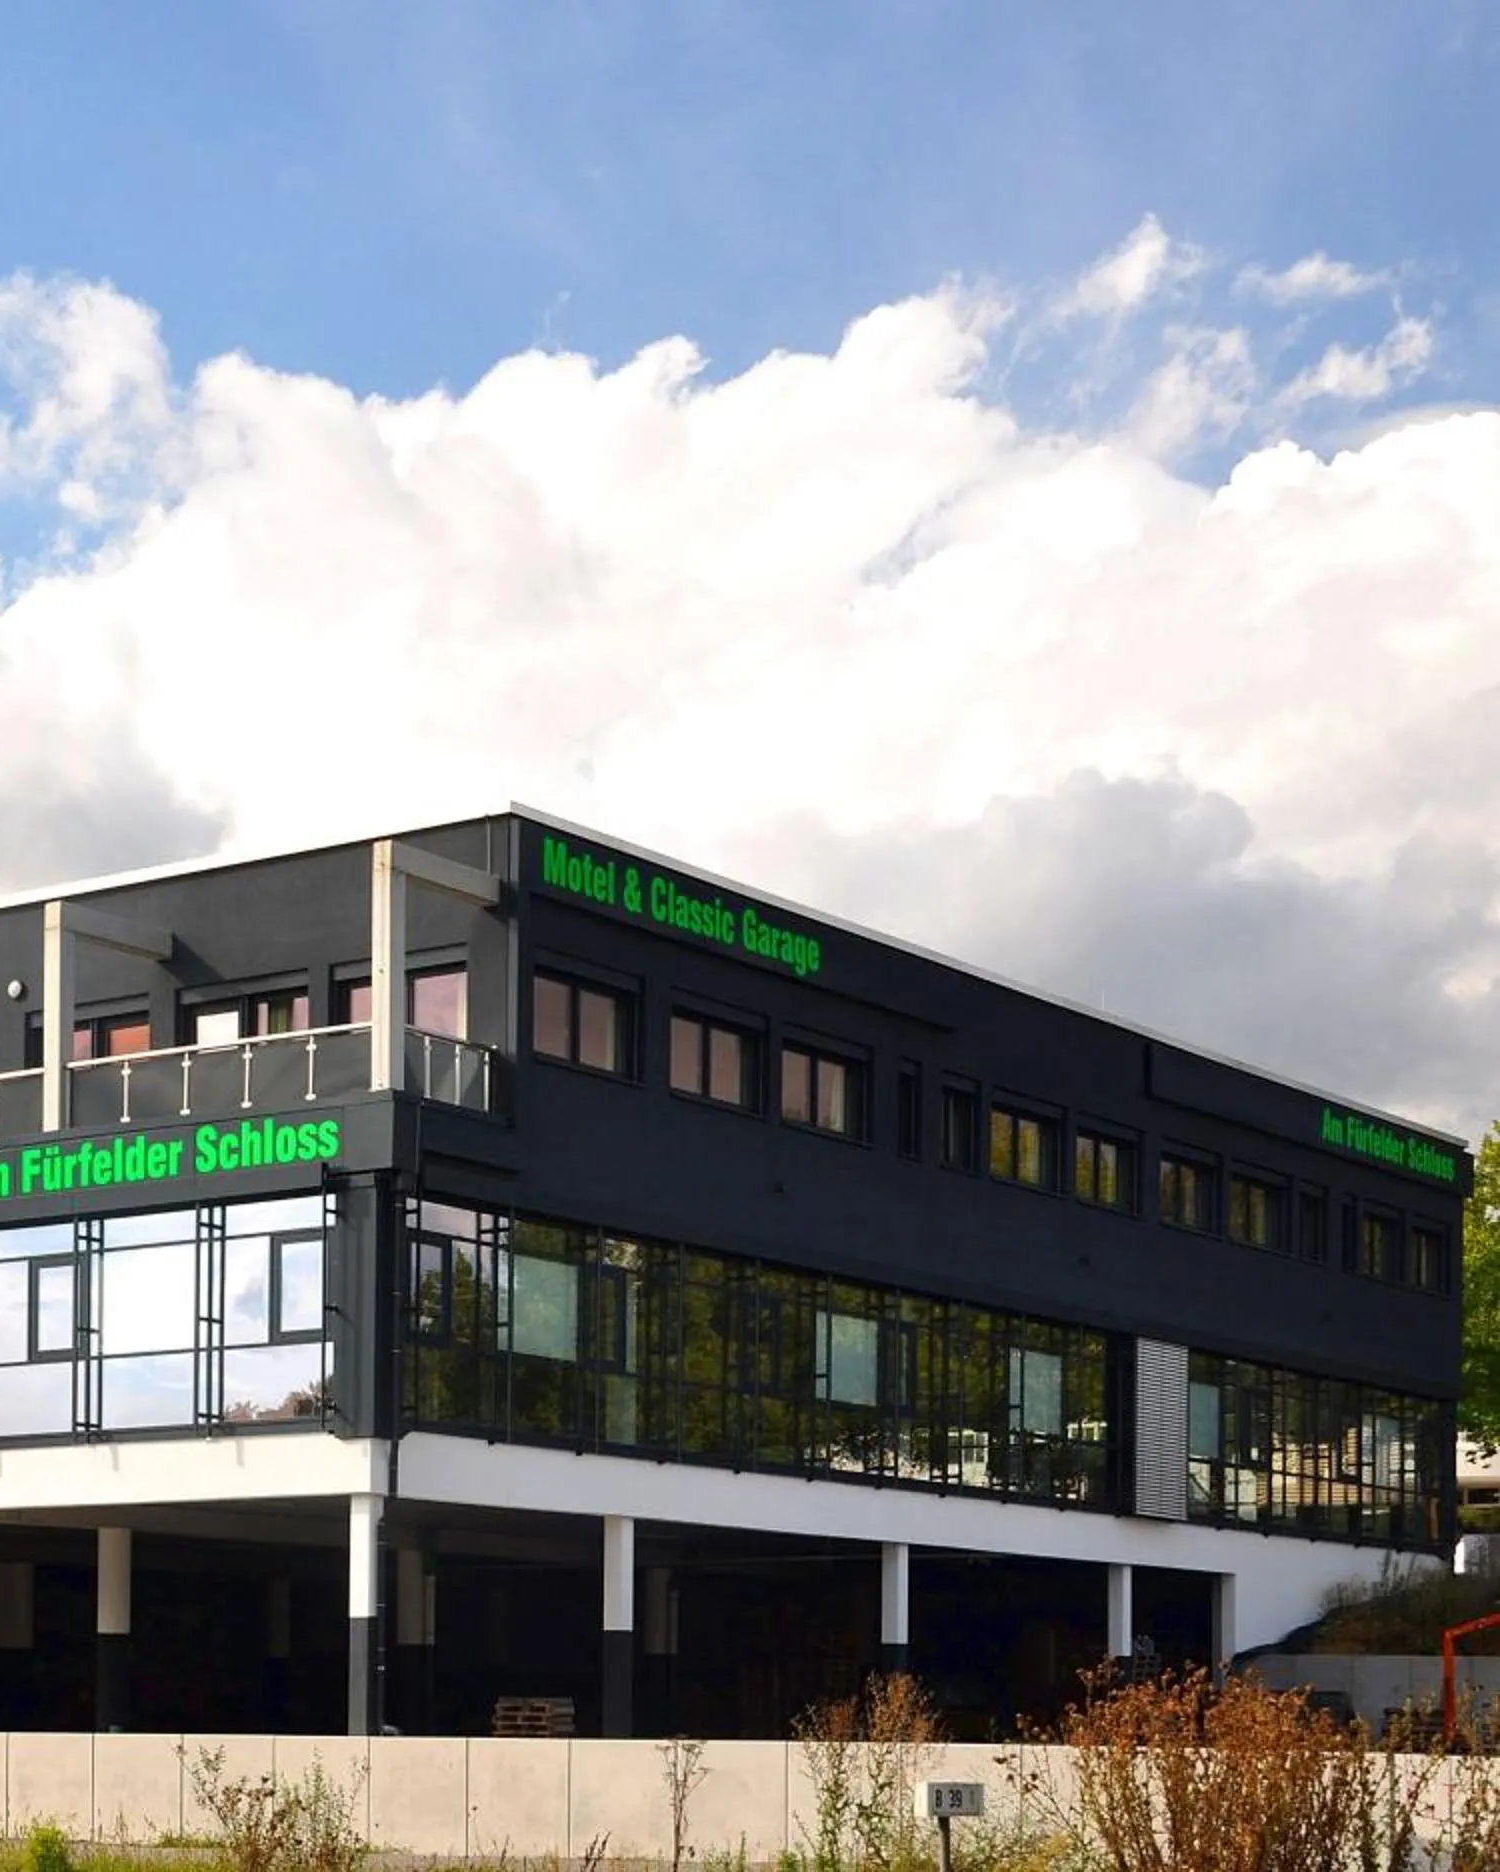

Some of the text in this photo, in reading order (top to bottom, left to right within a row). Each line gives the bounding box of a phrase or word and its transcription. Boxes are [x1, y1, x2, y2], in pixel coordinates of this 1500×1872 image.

[543, 835, 821, 977] Motel & Classic Garage
[19, 1133, 185, 1196] Fürfelder
[193, 1117, 342, 1175] Schloss
[1323, 1107, 1455, 1181] Am Fürfelder Schloss
[948, 1788, 963, 1808] 39
